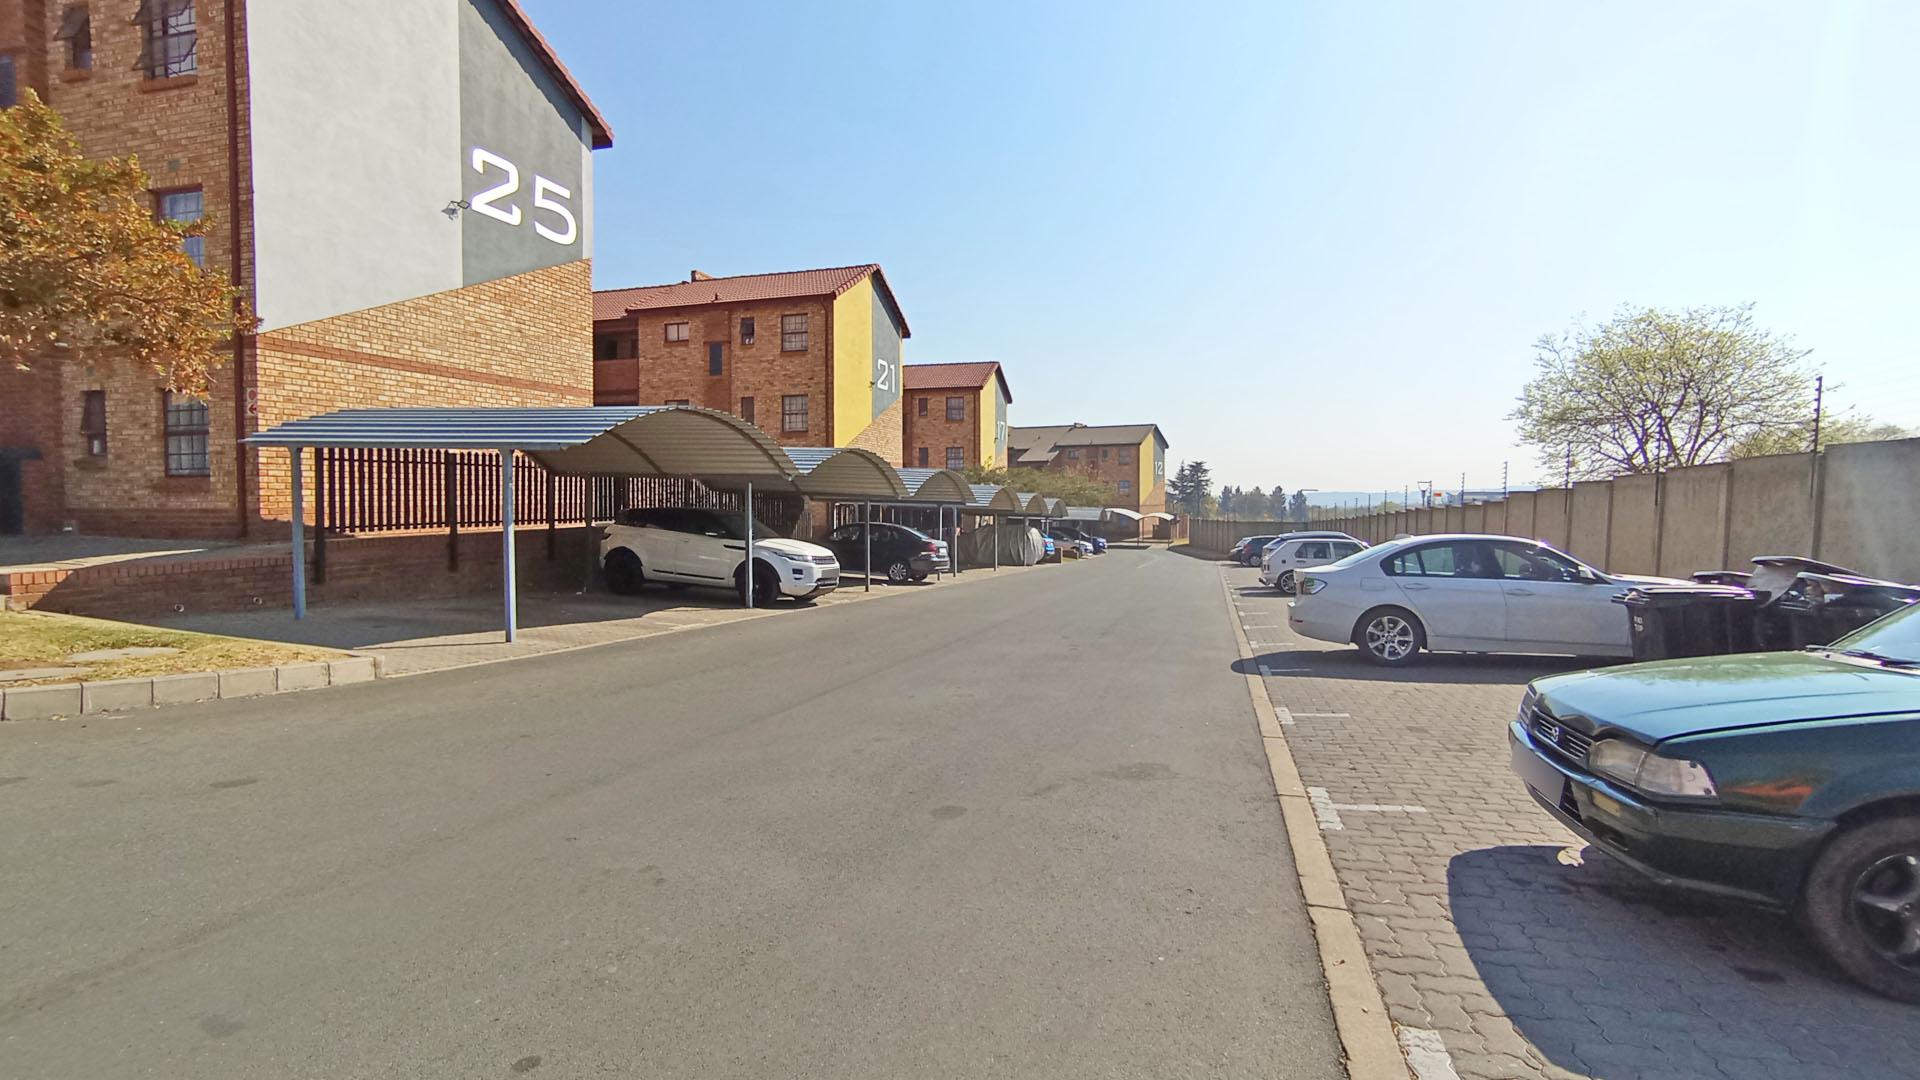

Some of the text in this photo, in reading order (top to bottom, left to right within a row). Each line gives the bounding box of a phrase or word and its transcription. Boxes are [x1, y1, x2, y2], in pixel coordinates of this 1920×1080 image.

[471, 147, 577, 245] 25
[877, 358, 895, 393] 21
[1154, 461, 1163, 476] 12
